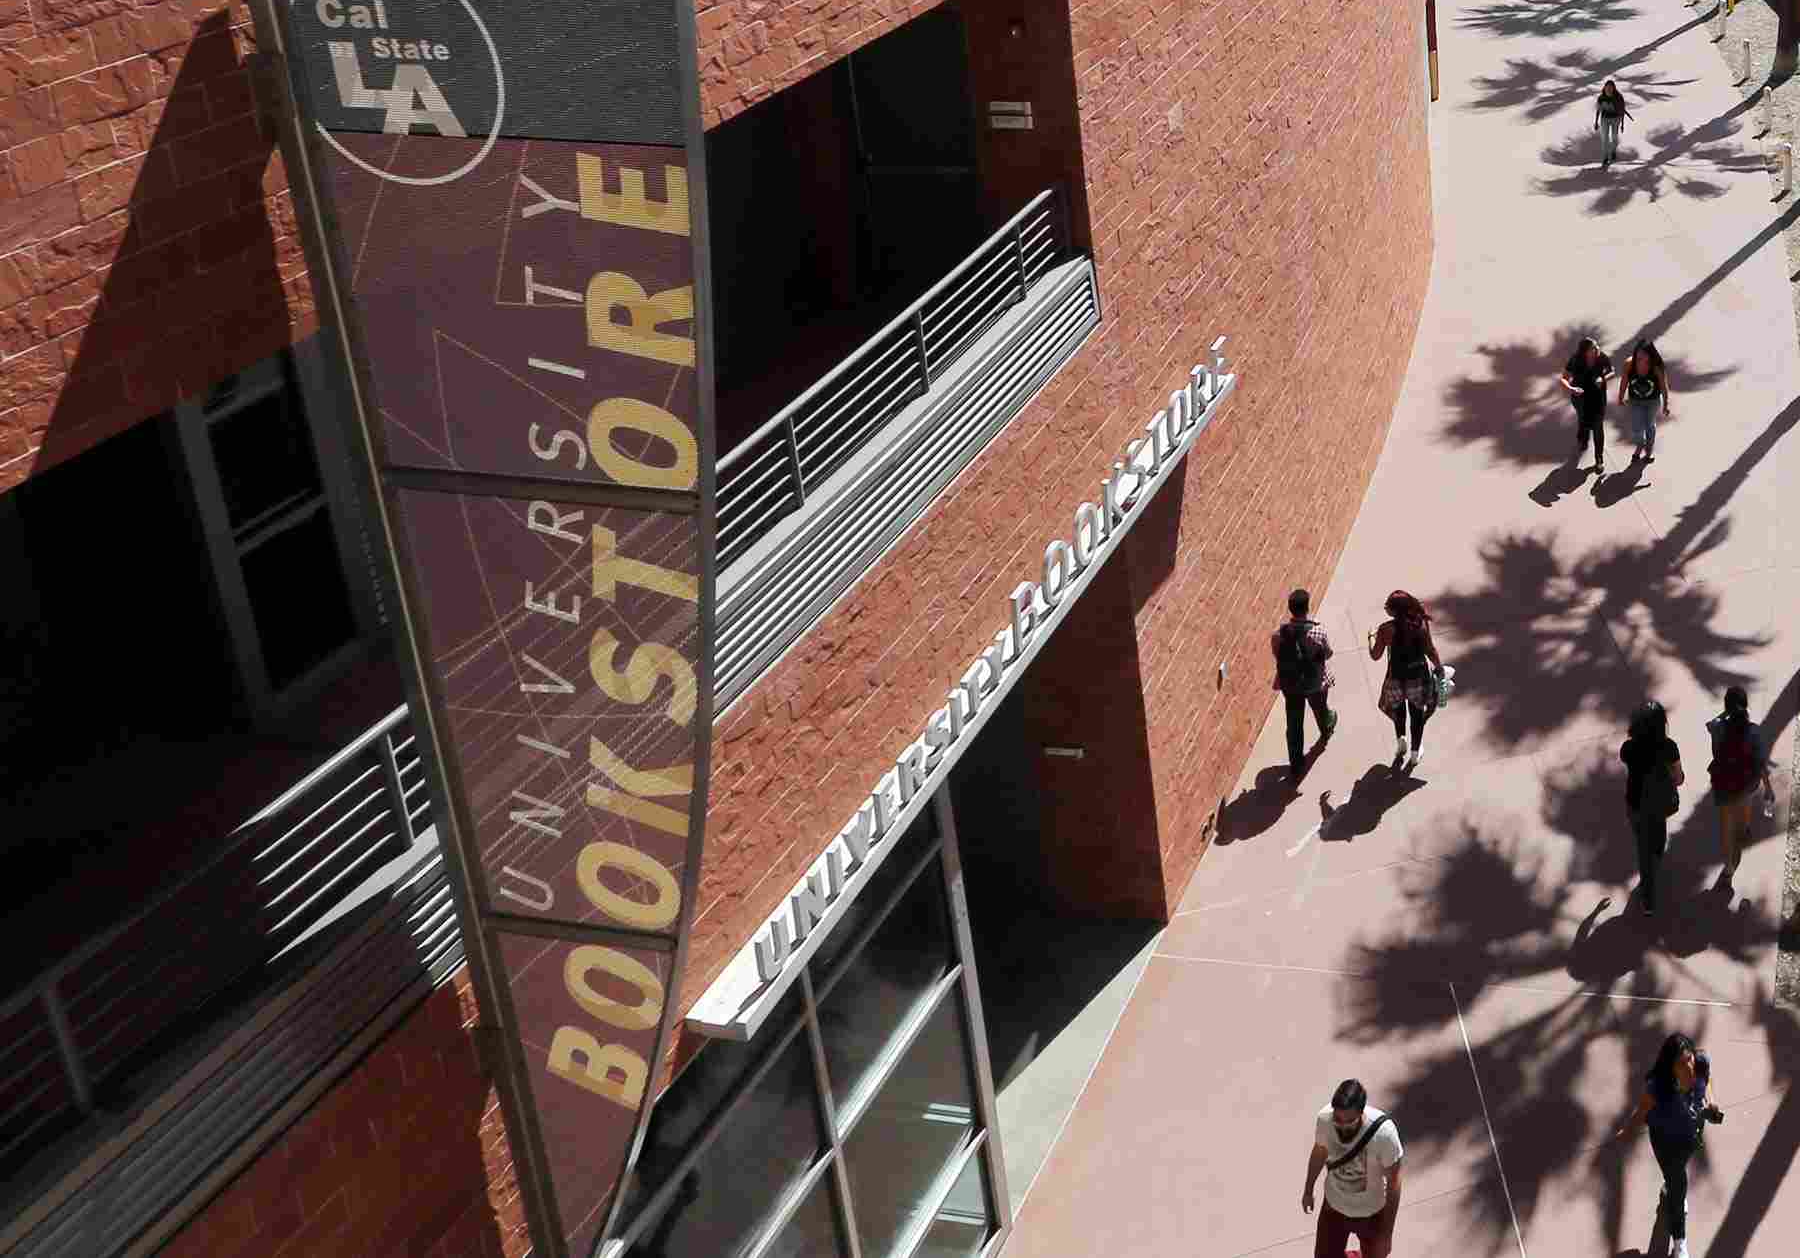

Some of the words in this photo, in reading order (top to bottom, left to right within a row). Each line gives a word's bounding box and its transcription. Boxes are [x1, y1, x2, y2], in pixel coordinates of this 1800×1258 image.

[328, 41, 468, 138] LA
[372, 36, 451, 63] State
[500, 171, 587, 913] UNIVERSITY
[547, 150, 699, 1110] BOOKSTORE
